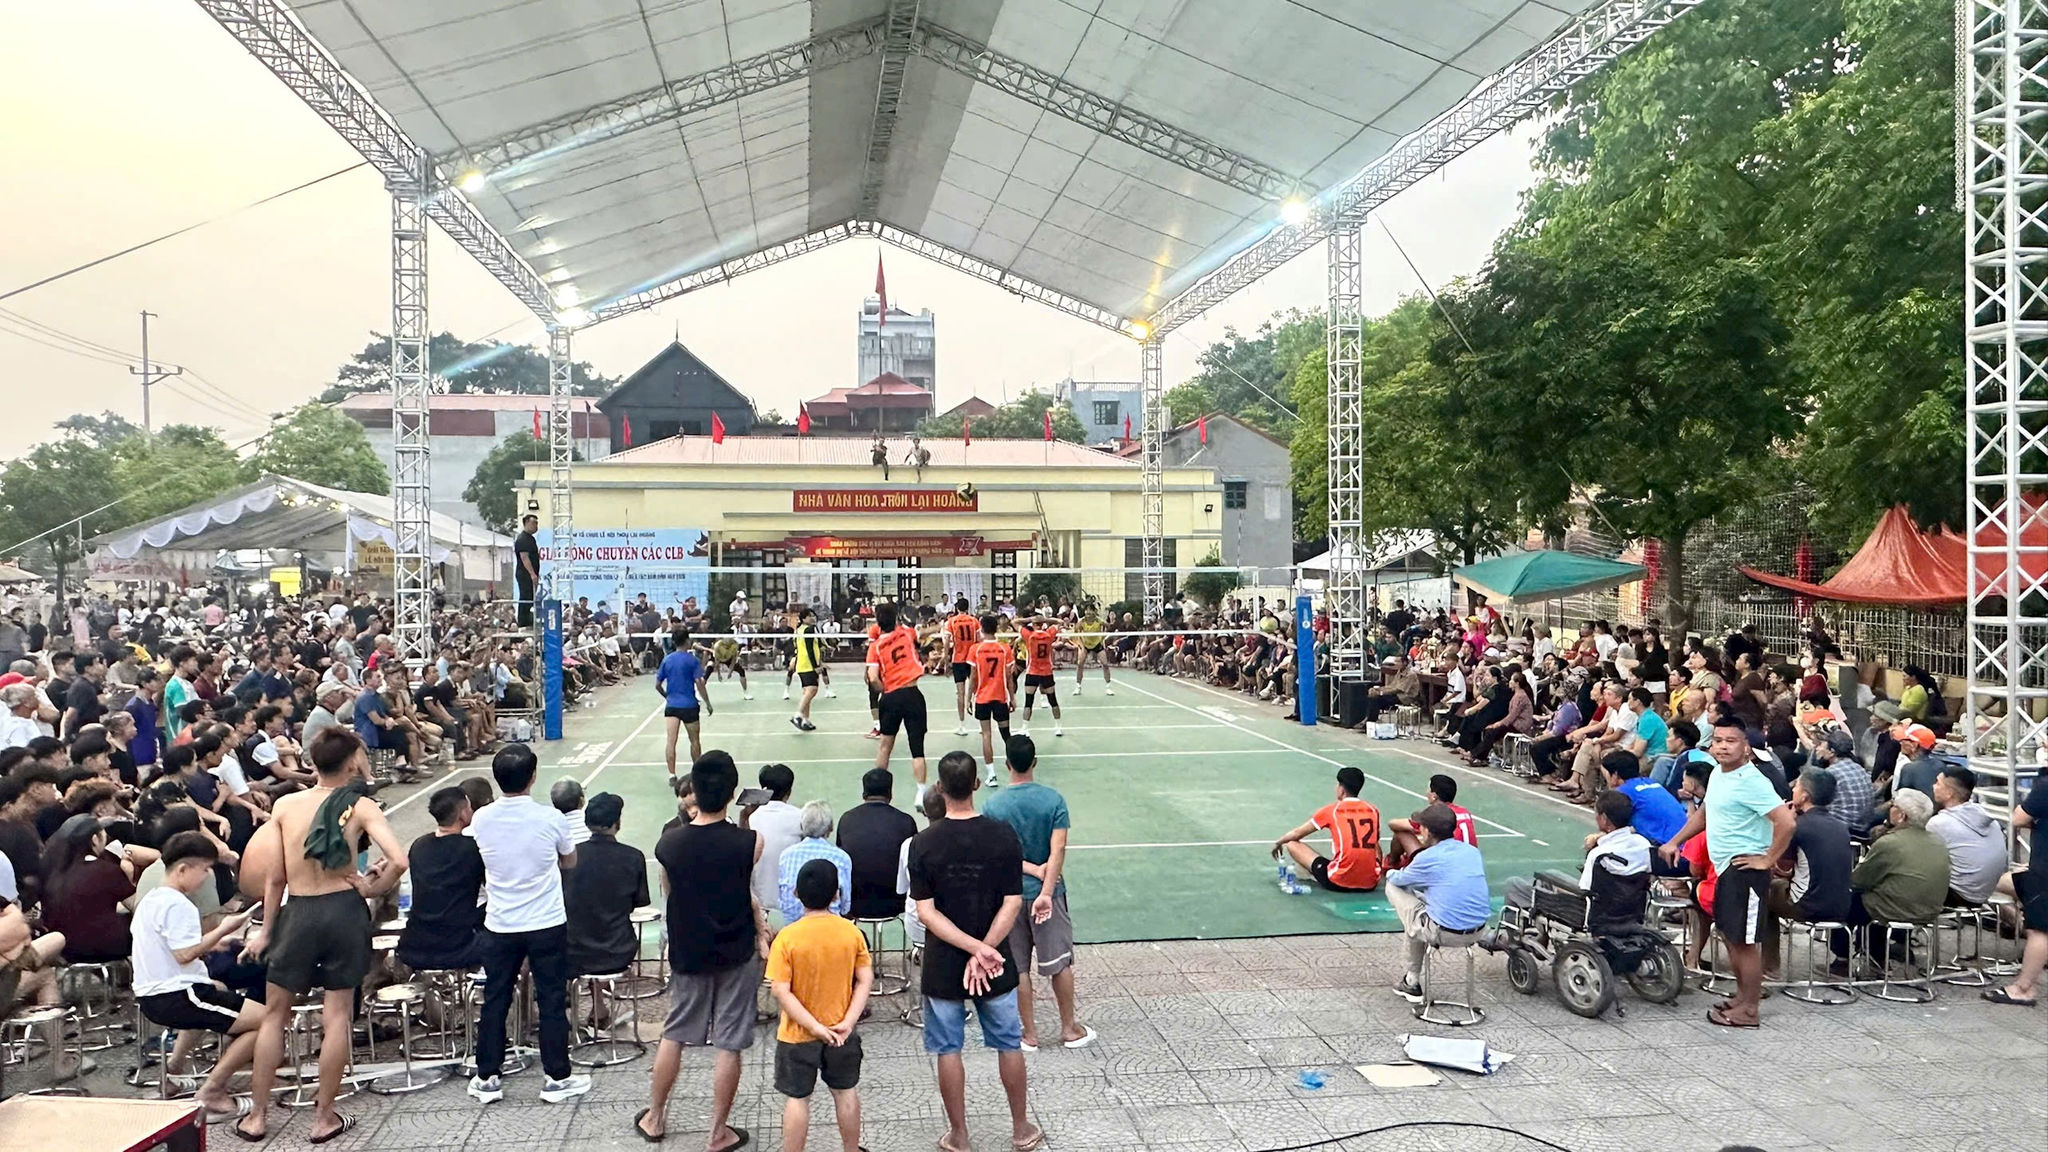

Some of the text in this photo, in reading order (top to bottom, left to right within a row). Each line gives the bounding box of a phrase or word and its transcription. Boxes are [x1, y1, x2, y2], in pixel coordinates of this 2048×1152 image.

[564, 543, 593, 560] ÓNG
[641, 542, 662, 560] CÁC
[664, 546, 684, 560] CLB
[959, 625, 972, 641] 11
[1037, 643, 1048, 659] 8
[985, 657, 999, 678] 7
[1347, 818, 1376, 848] 12
